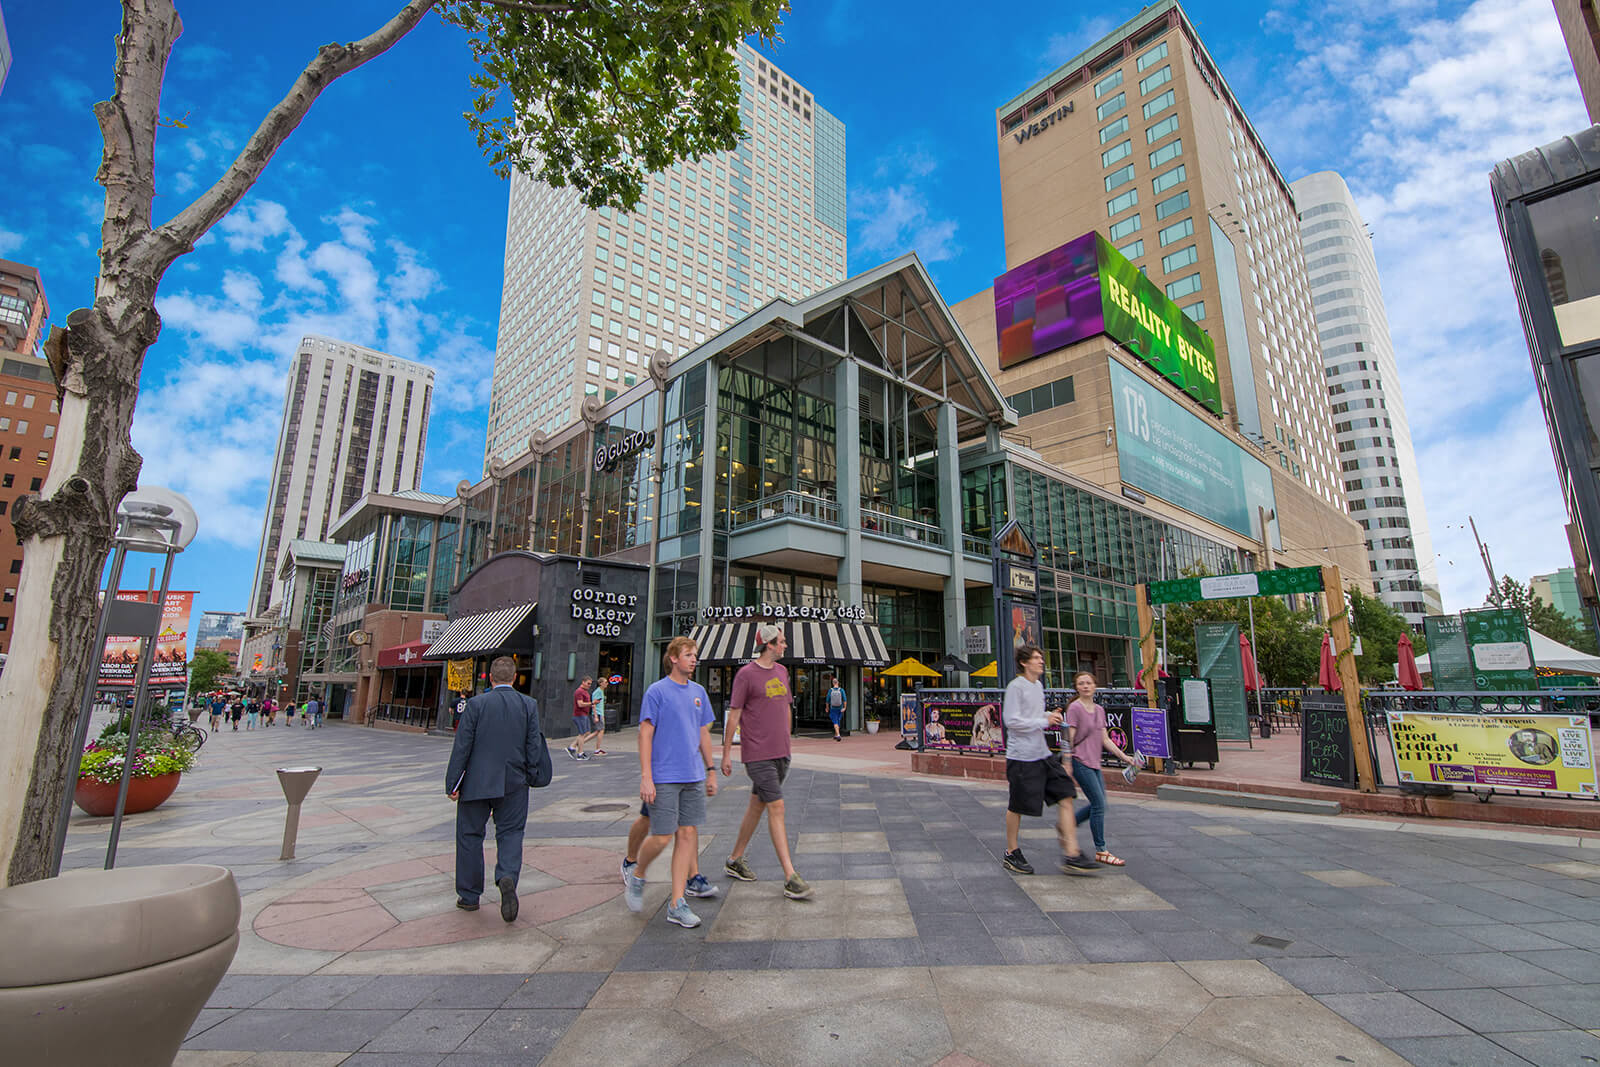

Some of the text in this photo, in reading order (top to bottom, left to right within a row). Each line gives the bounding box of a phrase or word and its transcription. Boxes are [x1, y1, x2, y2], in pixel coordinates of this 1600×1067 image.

[1014, 100, 1074, 144] WESTIN
[1108, 274, 1216, 384] REALITY BYTES
[1122, 385, 1150, 442] 173
[608, 430, 644, 460] GUSTO
[572, 588, 637, 606] corner
[572, 604, 636, 624] bakery
[762, 603, 832, 621] bakery
[838, 605, 866, 619] cafe
[586, 622, 621, 636] cafe
[1310, 712, 1324, 733] 3
[1394, 732, 1437, 741] Great
[1308, 740, 1344, 760] BEER
[1396, 742, 1458, 752] Podcast
[1399, 752, 1410, 760] of
[1312, 758, 1332, 772] $12
